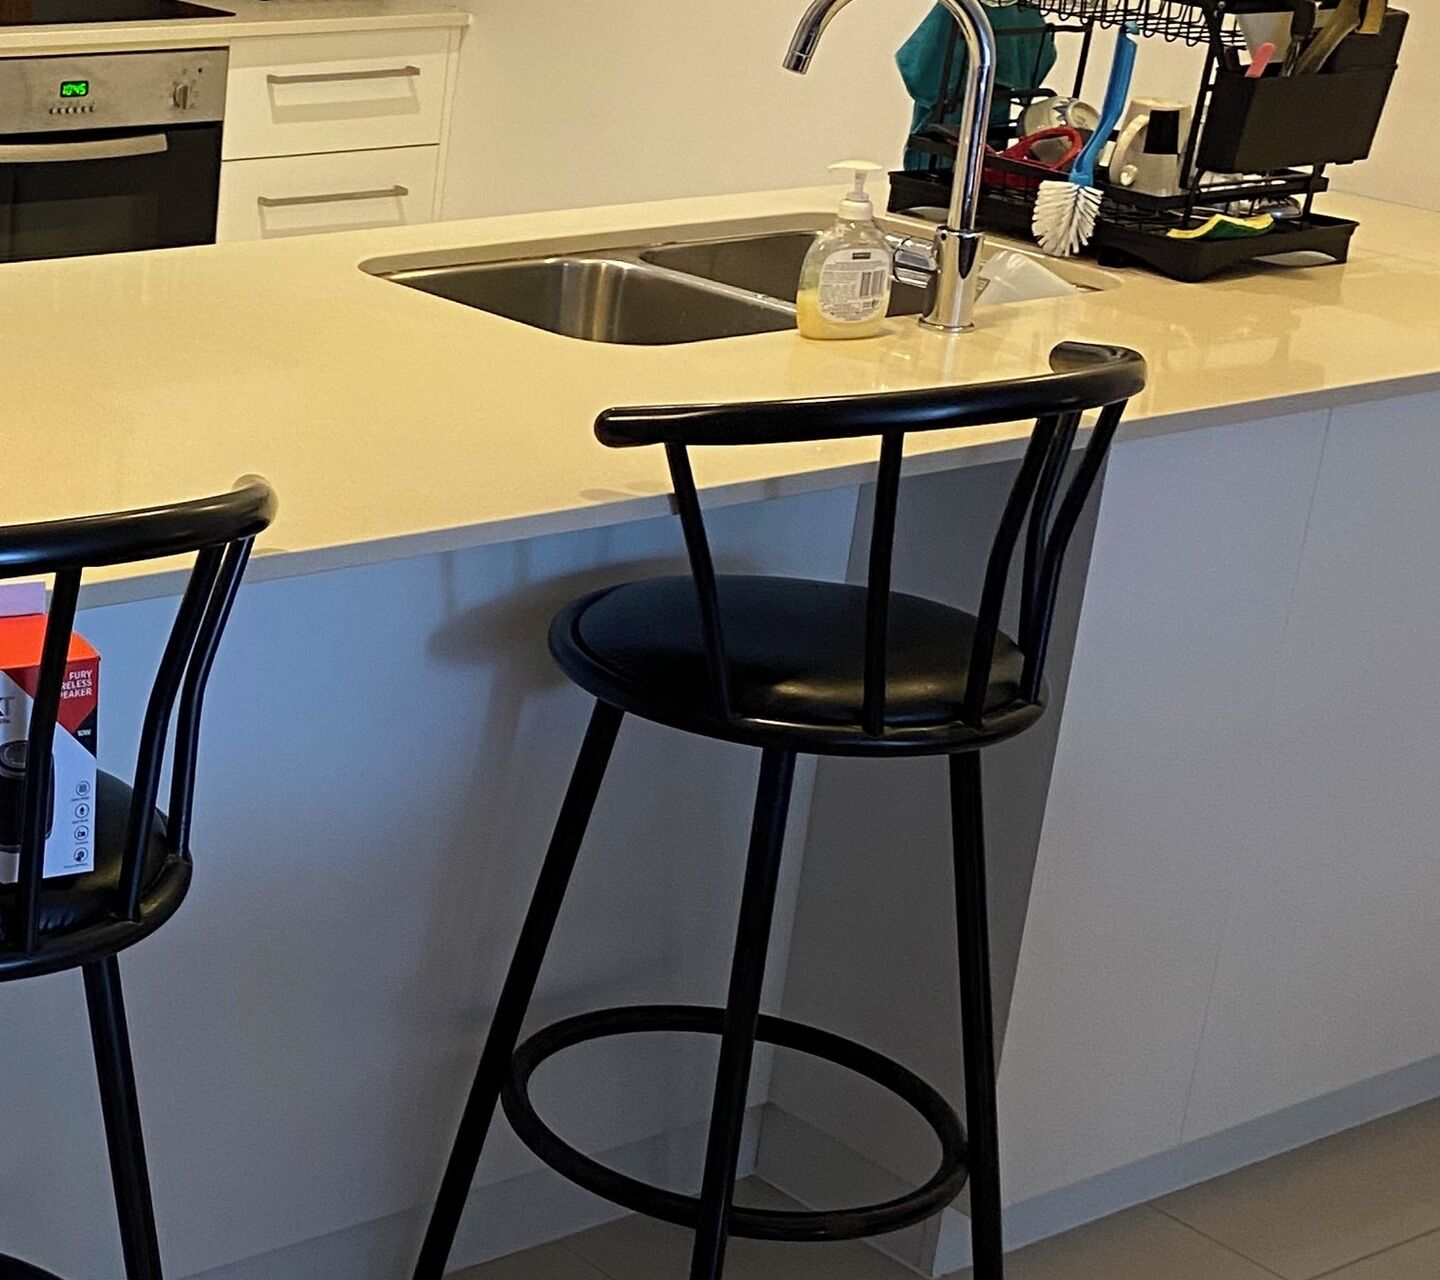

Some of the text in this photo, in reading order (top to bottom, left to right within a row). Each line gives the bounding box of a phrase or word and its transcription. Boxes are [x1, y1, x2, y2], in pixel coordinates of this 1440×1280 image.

[69, 670, 93, 680] FURY
[62, 679, 92, 690] RELESS
[61, 688, 92, 699] EAKER
